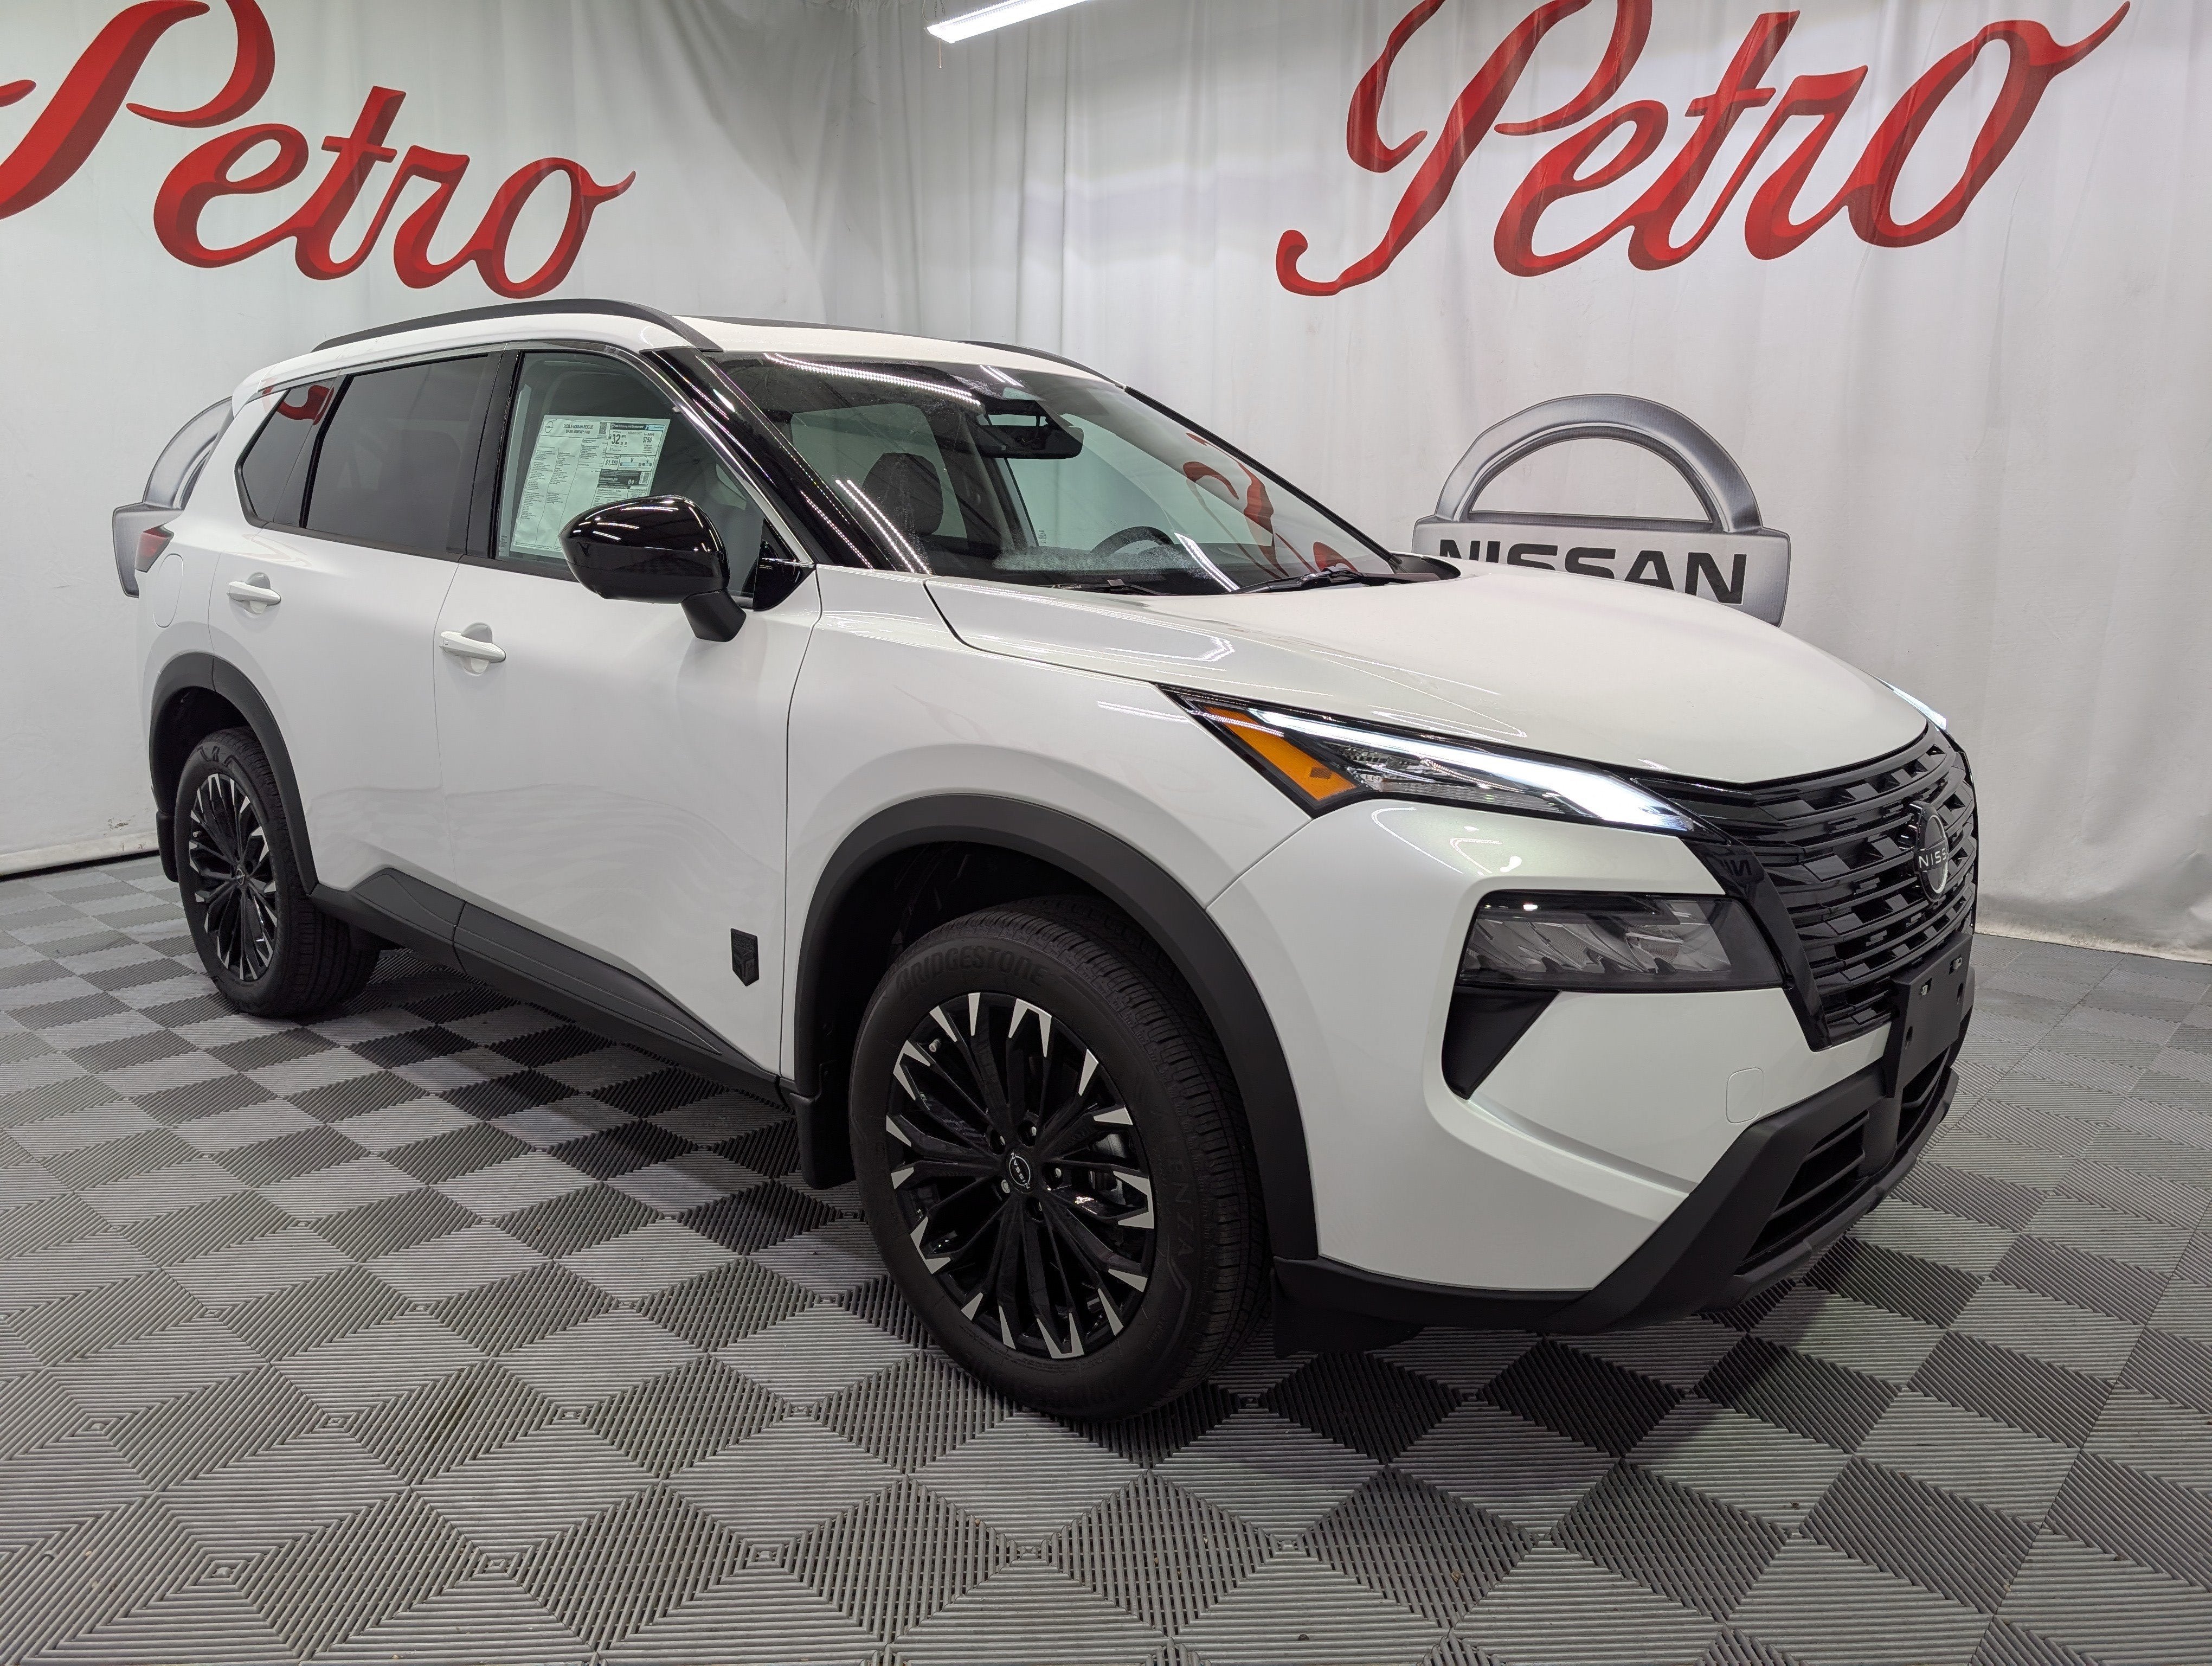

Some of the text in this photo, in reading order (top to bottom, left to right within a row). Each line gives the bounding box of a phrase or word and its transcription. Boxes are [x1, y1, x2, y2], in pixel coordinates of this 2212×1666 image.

[0, 0, 636, 299] Petro
[1275, 0, 2131, 297] Petro
[612, 434, 621, 445] 32
[1918, 847, 1949, 868] NISS
